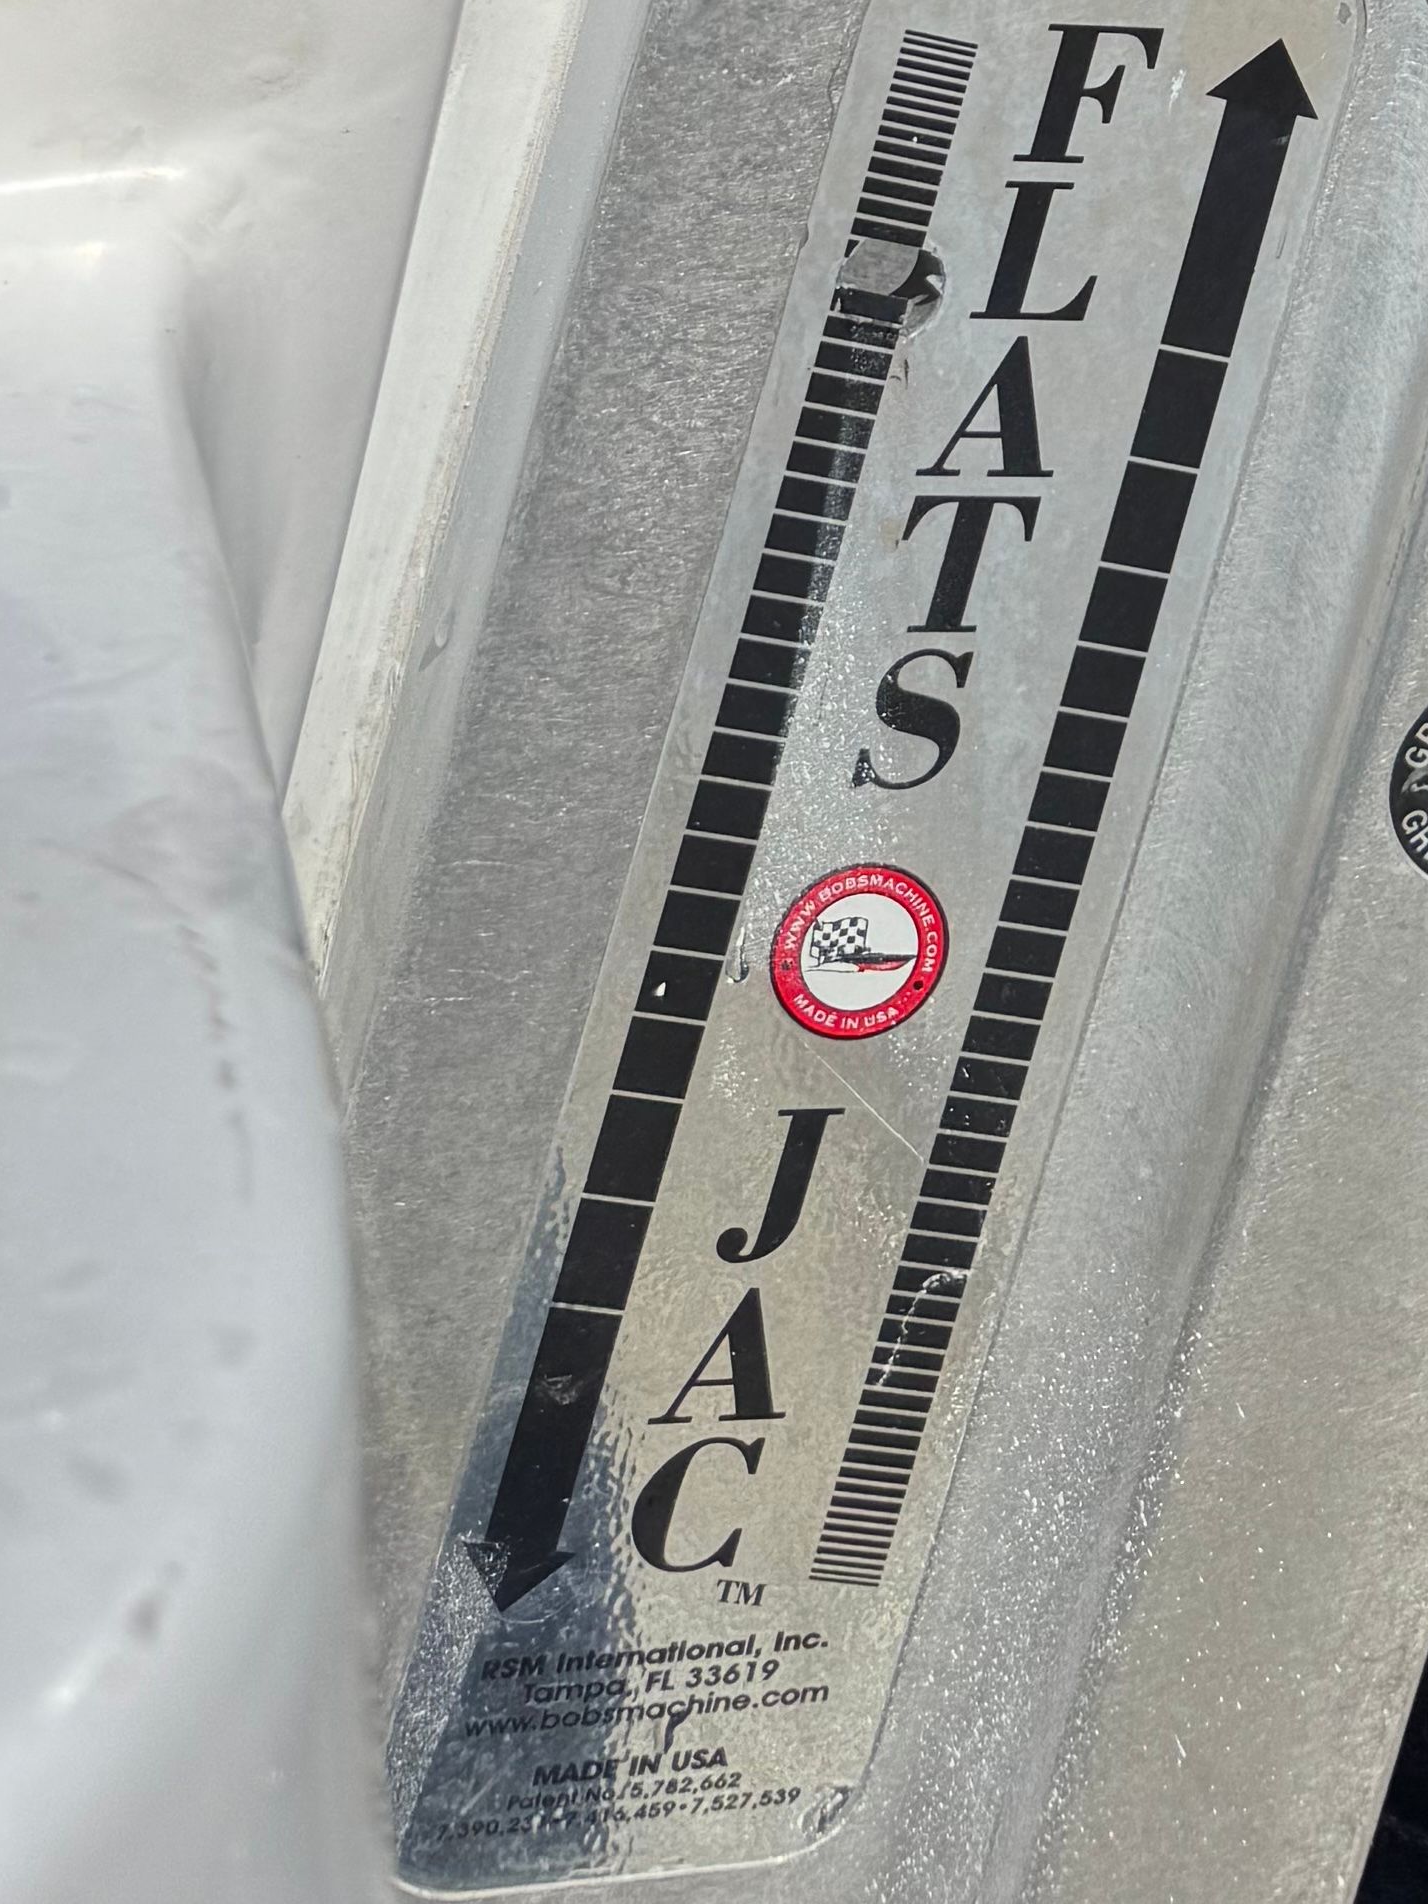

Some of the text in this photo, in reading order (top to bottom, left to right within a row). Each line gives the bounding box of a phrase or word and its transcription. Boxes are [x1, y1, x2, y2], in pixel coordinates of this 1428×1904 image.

[852, 23, 1164, 790] FLATS
[793, 993, 900, 1030] MADE IN USA
[631, 1107, 846, 1572] JAC
[716, 1579, 767, 1607] TM
[481, 1630, 830, 1682] RSM International, Inc.
[644, 1669, 675, 1694] FL
[684, 1659, 780, 1689] 33619
[464, 1683, 831, 1739] www.bobsmachine.com
[532, 1746, 729, 1787] MADE IN USA
